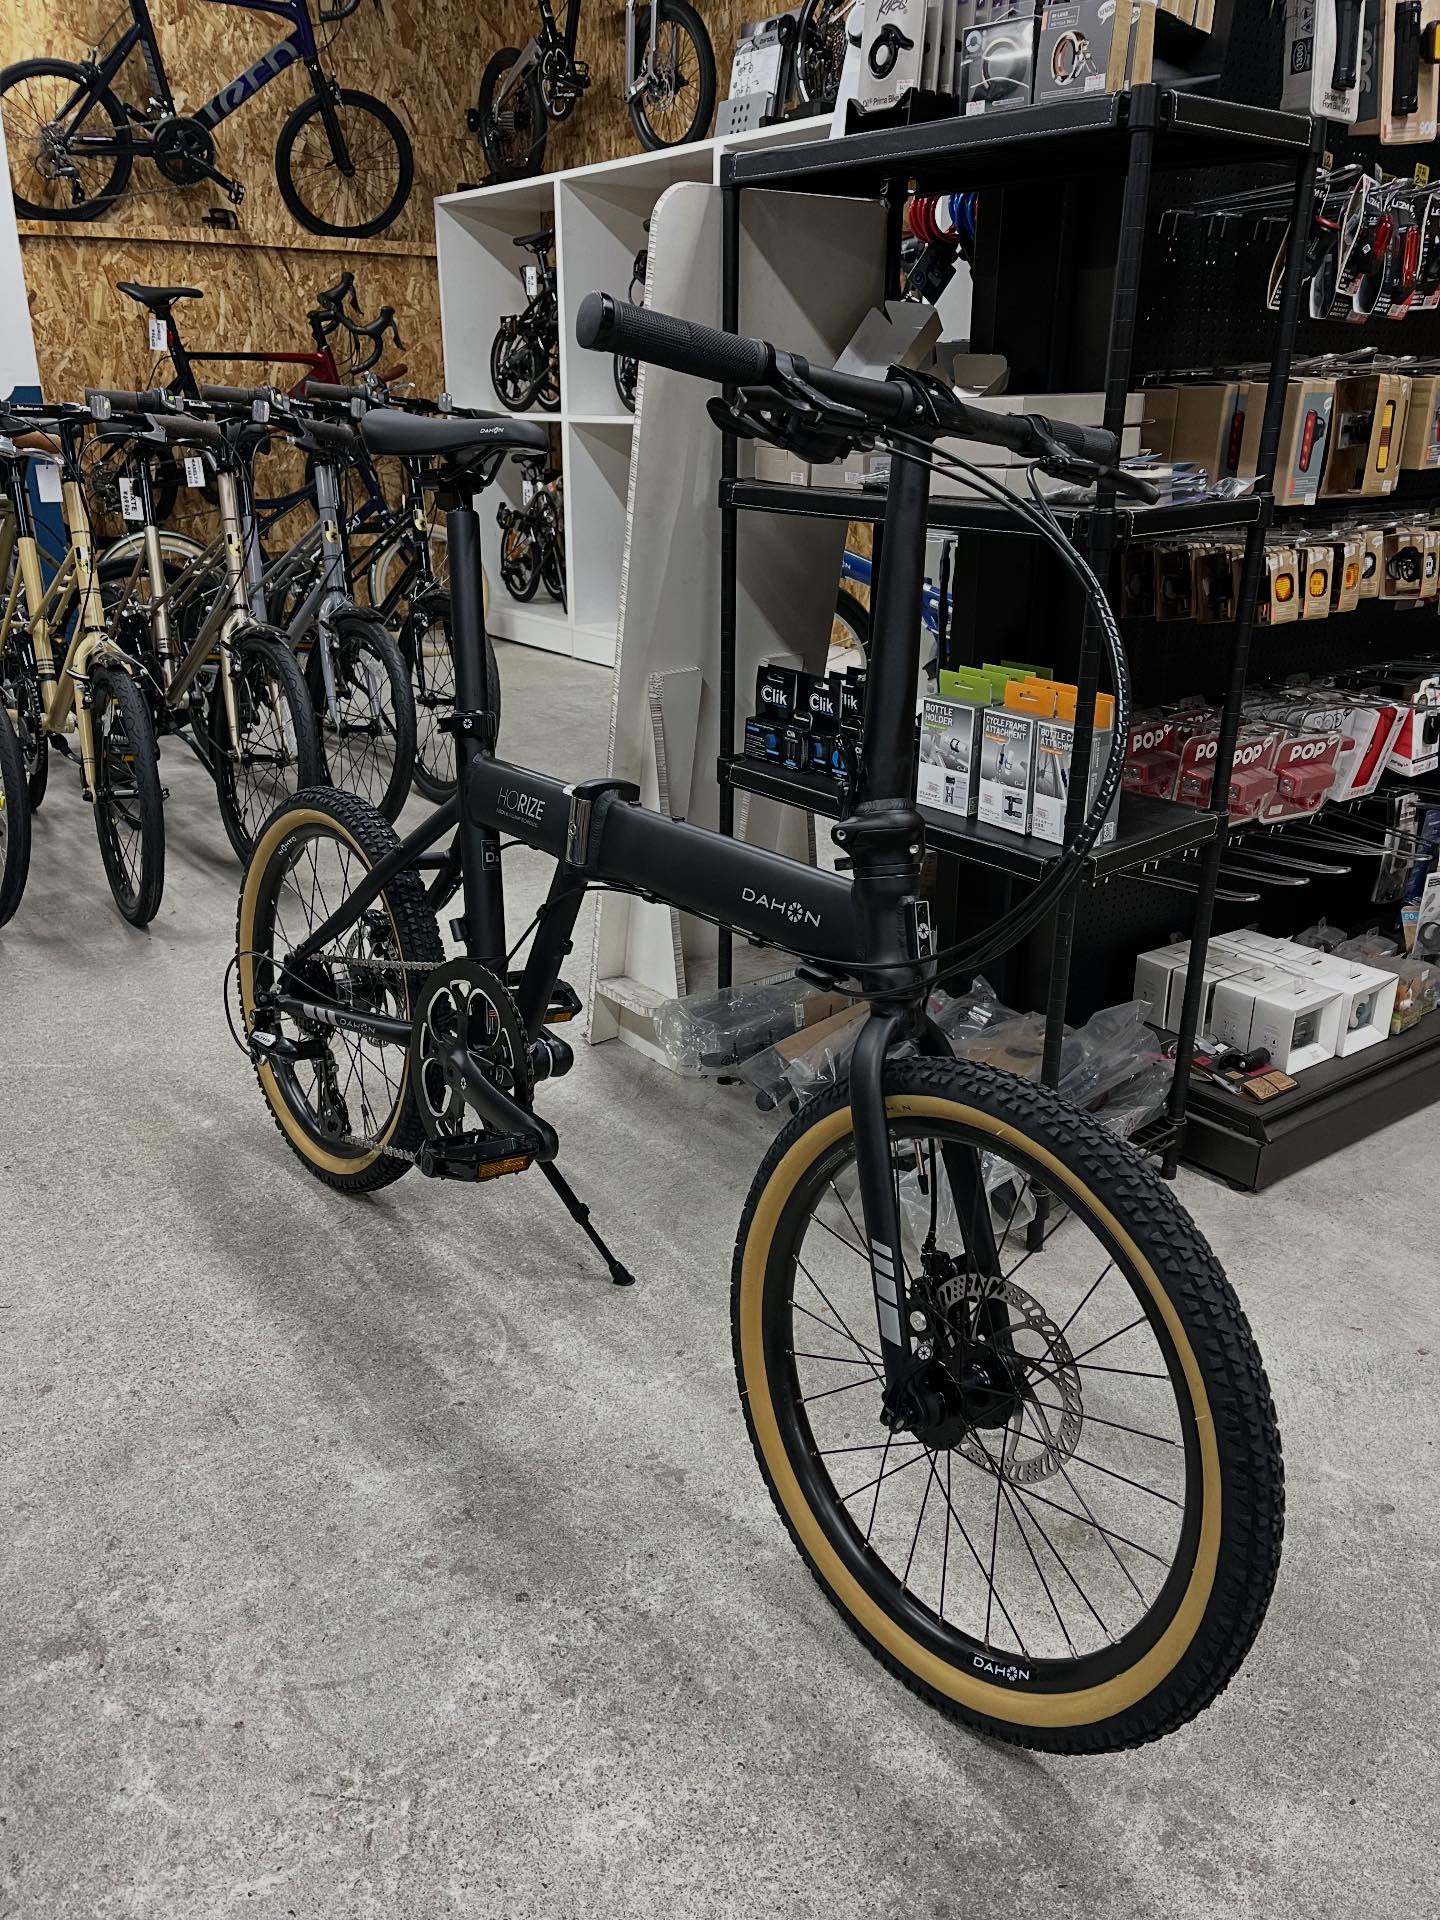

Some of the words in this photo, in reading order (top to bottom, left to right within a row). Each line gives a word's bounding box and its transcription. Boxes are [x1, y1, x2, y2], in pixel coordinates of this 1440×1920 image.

[480, 426, 505, 434] DAHON
[760, 684, 788, 706] Clik
[808, 692, 834, 714] Clik
[841, 692, 858, 711] lik
[925, 702, 954, 717] BOTTLE
[925, 711, 953, 727] HOLDER
[985, 724, 1027, 741] ATTACHMENT
[986, 715, 1006, 727] CYCLE
[1004, 719, 1028, 733] FRAME
[1040, 728, 1066, 741] BOTTLE
[1132, 729, 1164, 752] POP
[1194, 741, 1218, 762] PO
[1232, 744, 1263, 768] POP
[1289, 741, 1327, 763] POP
[497, 787, 546, 821] HORIZE
[741, 887, 821, 928] DAHON
[340, 1018, 377, 1035] DAHON
[972, 1656, 1030, 1682] DAHON
